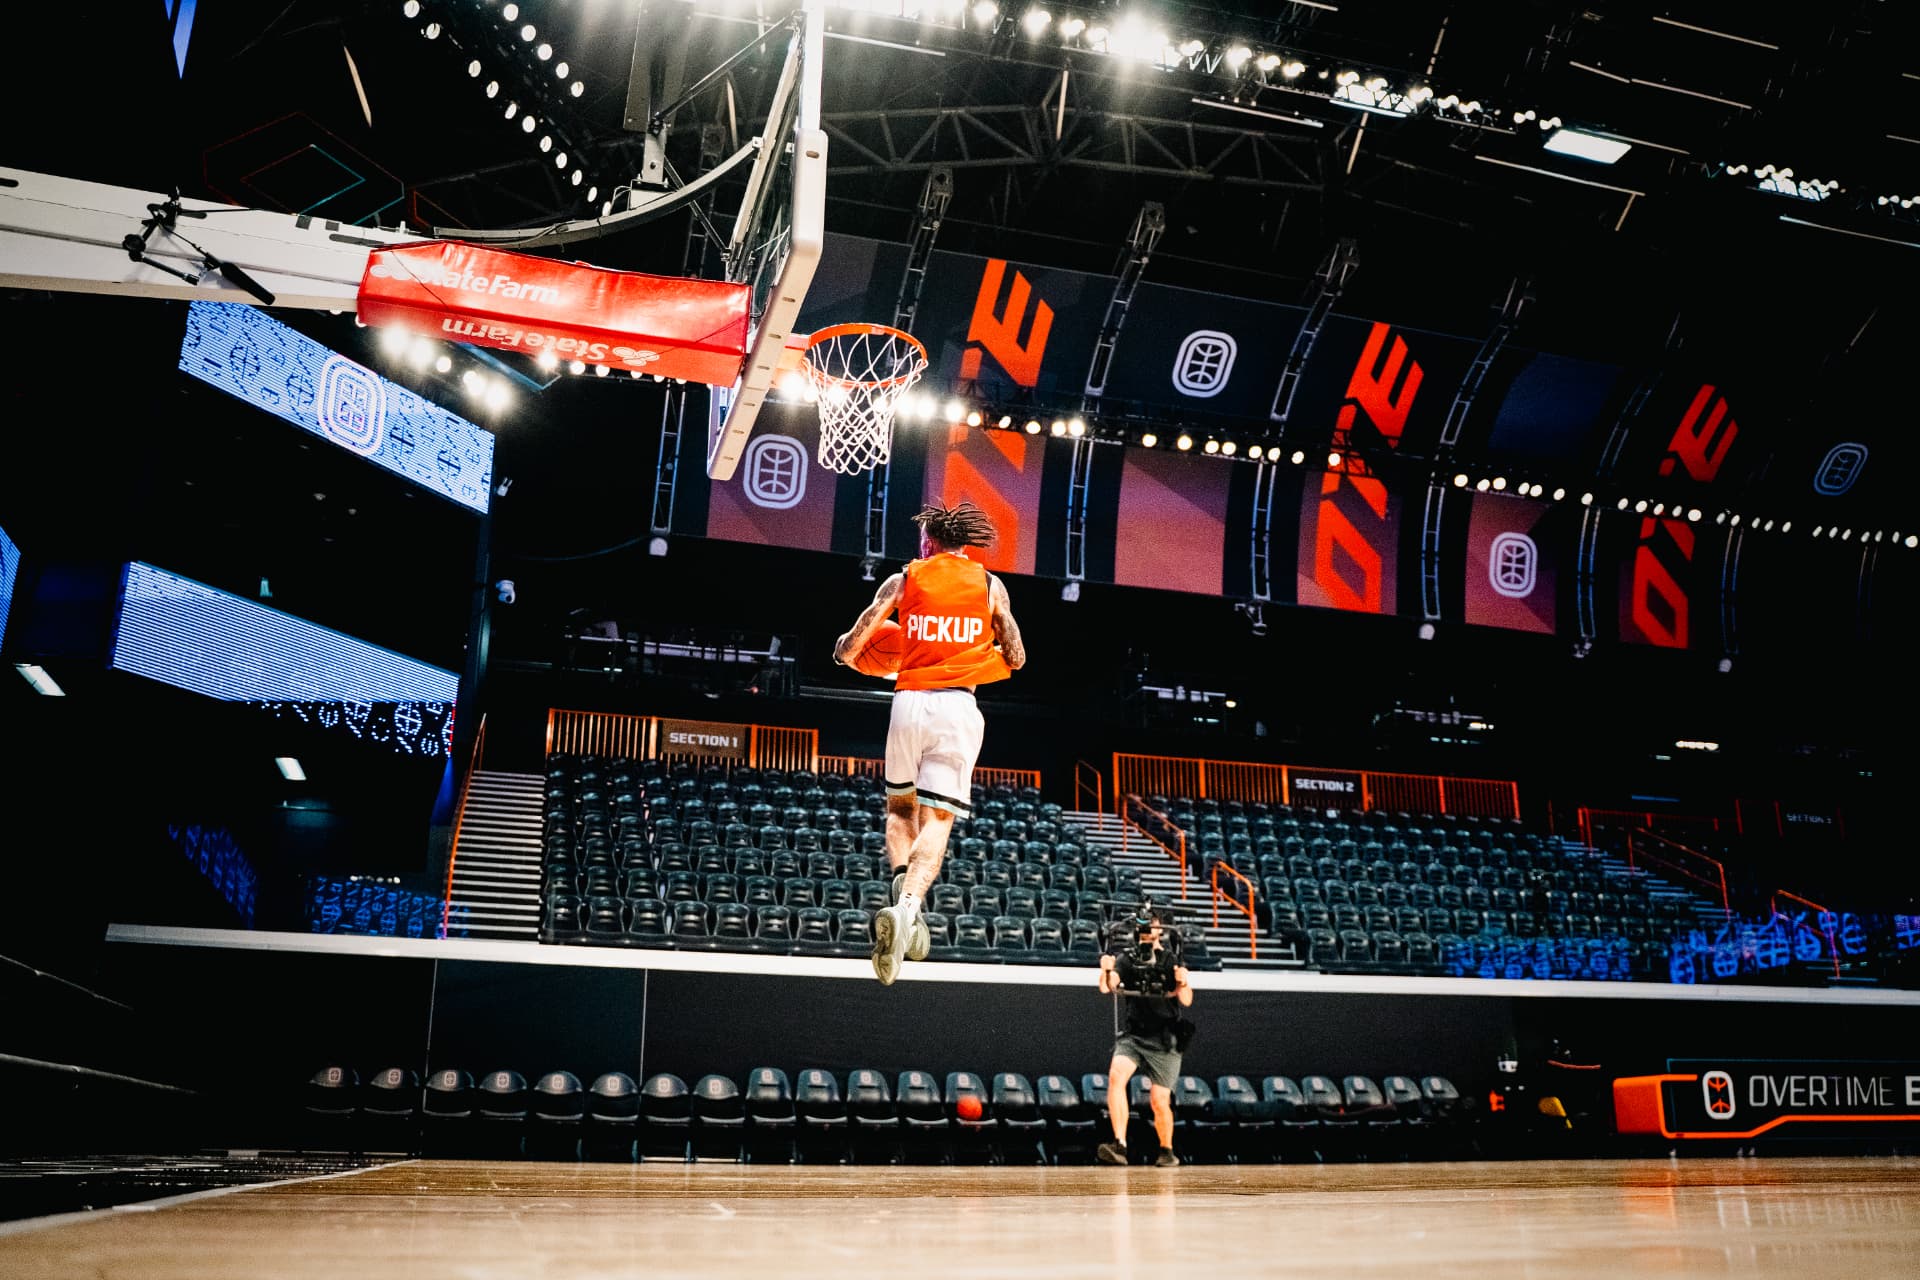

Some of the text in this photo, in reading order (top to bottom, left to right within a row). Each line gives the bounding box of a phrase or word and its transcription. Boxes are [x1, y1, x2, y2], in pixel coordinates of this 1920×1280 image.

[907, 613, 983, 644] PICKUP
[669, 731, 738, 748] SECTION 1
[1295, 778, 1354, 792] SECTION 2
[1749, 1075, 1895, 1107] OVERTIME
